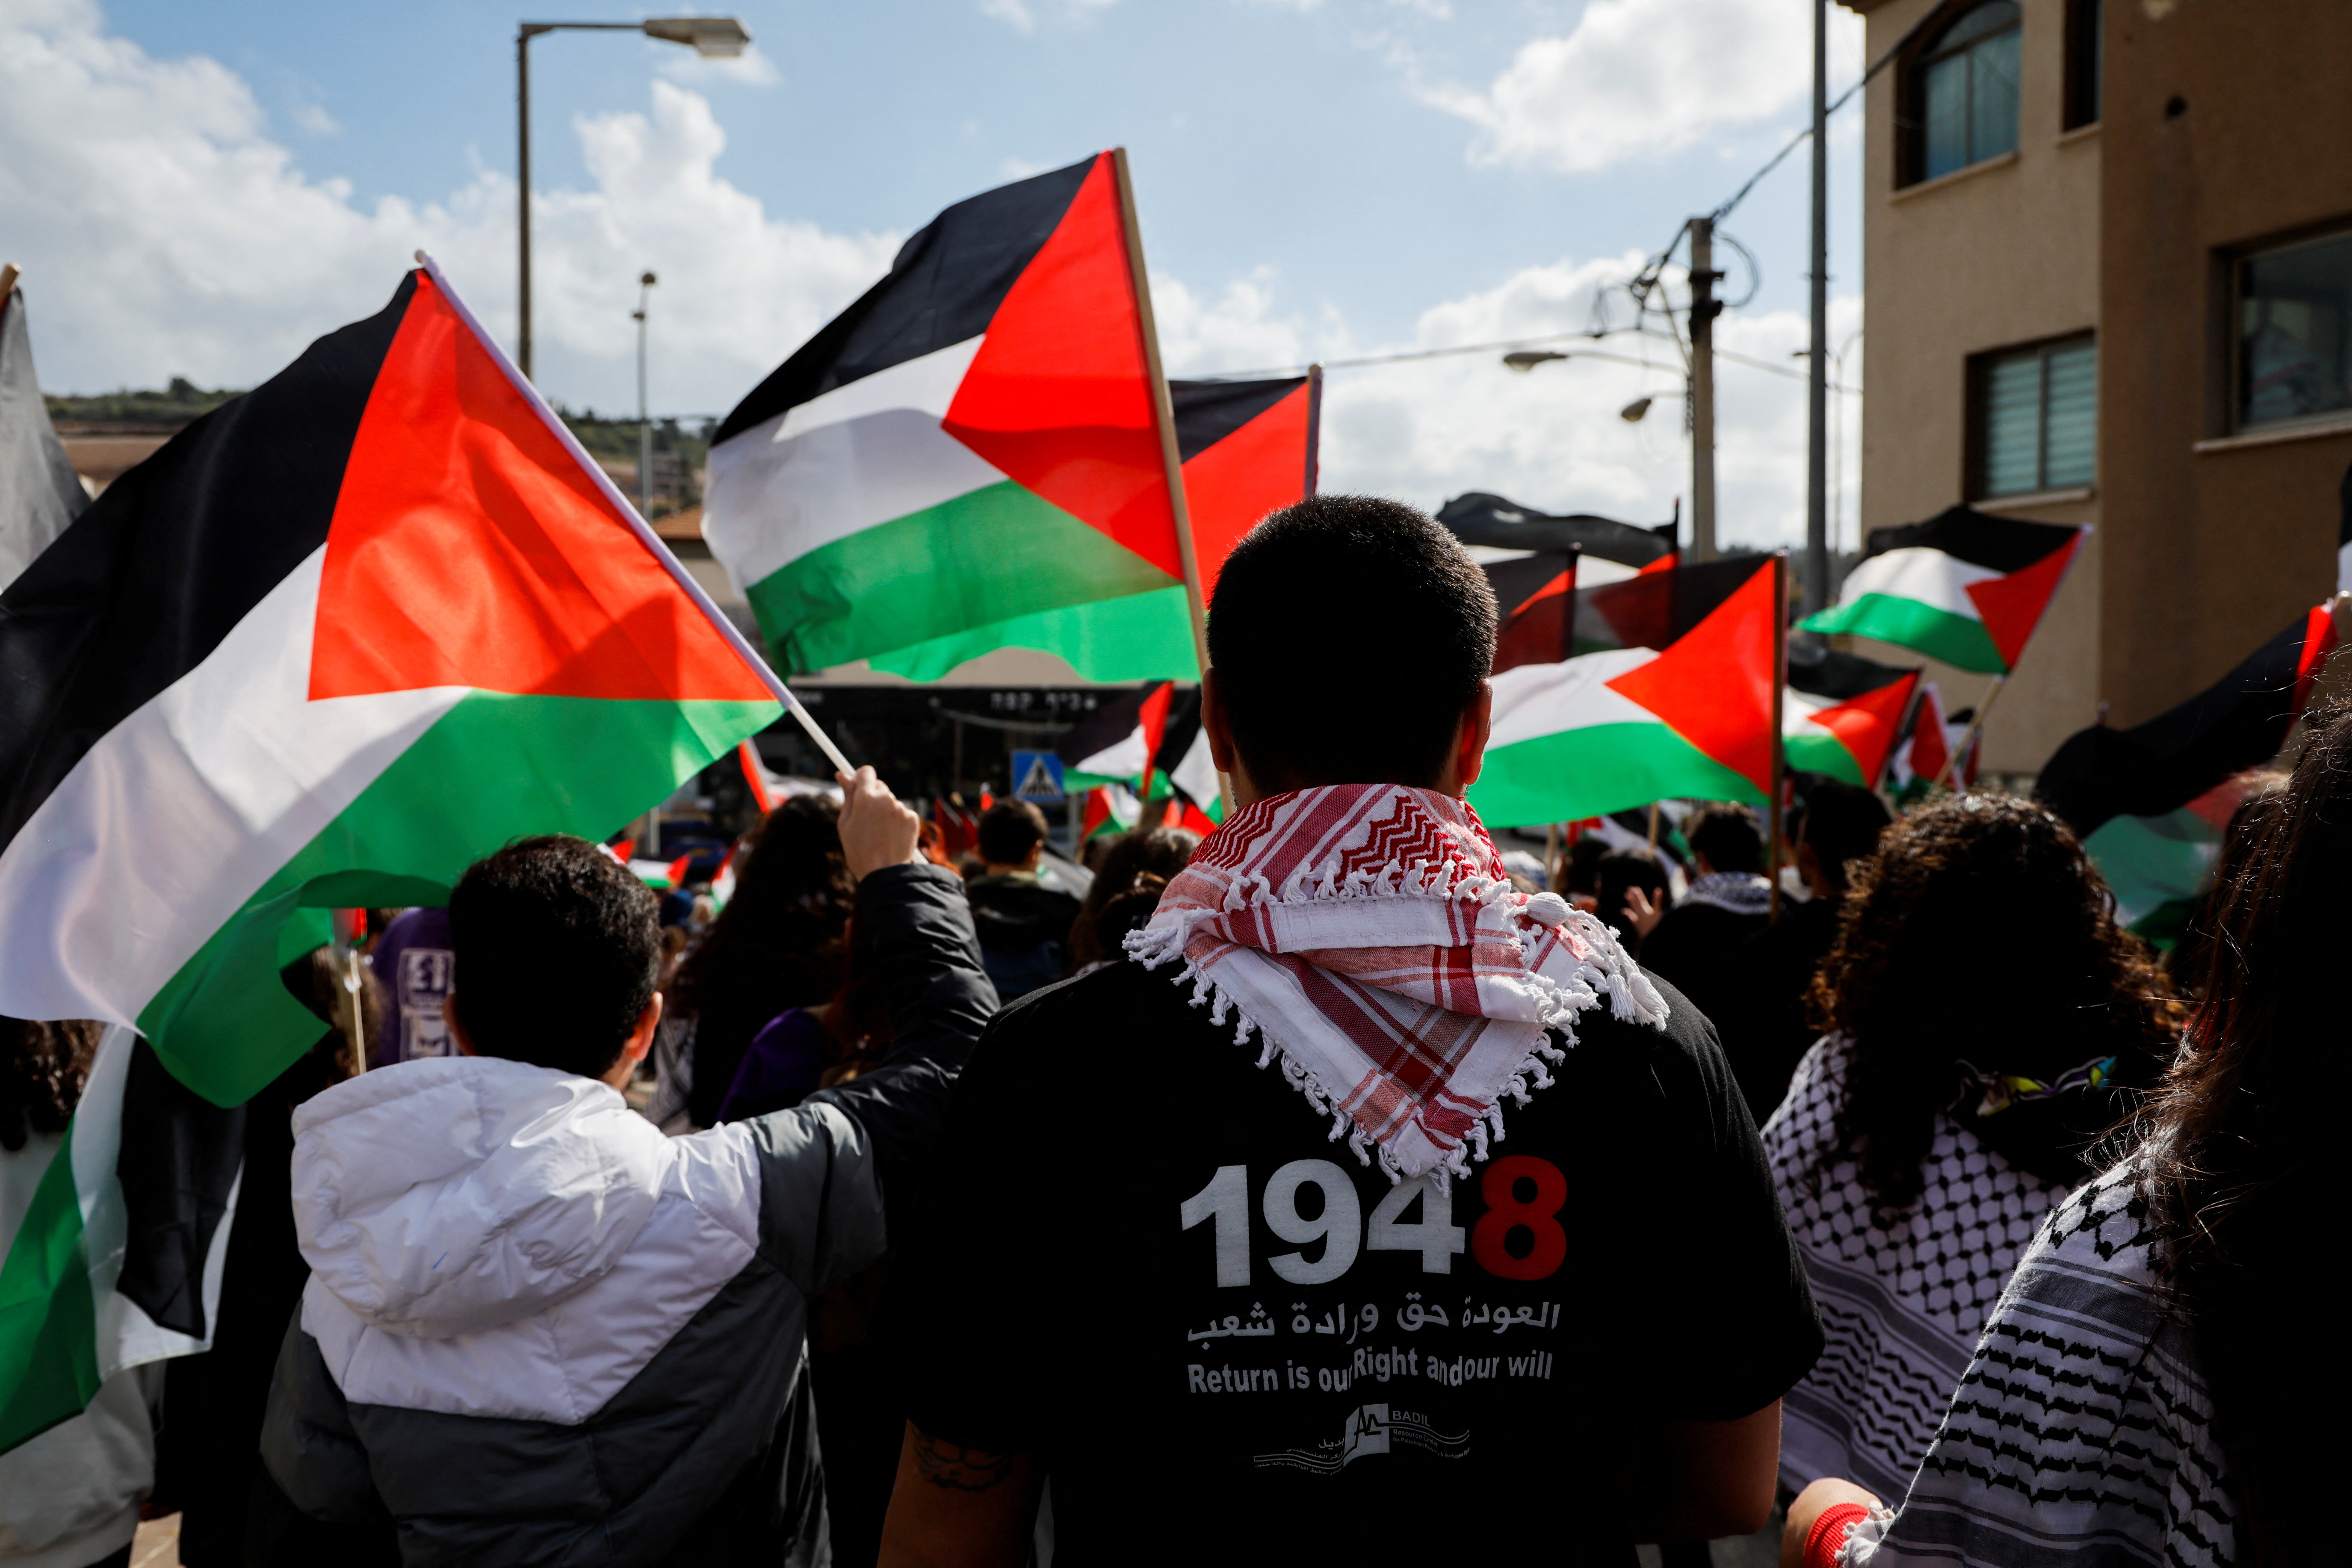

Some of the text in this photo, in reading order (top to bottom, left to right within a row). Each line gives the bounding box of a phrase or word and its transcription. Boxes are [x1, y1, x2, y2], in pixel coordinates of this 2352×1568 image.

[1181, 1156, 1567, 1287] 1948
[1188, 1302, 1275, 1350] شعب
[1397, 1292, 1449, 1332] حق
[1463, 1296, 1560, 1334] العودة
[1188, 1364, 1278, 1393] Return
[1287, 1360, 1310, 1389] is
[1354, 1346, 1418, 1382] Right
[1508, 1350, 1553, 1380] will
[1392, 1411, 1430, 1427] BADIL
[1393, 1429, 1438, 1447] Resource Center
[1318, 1437, 1344, 1450] بديل
